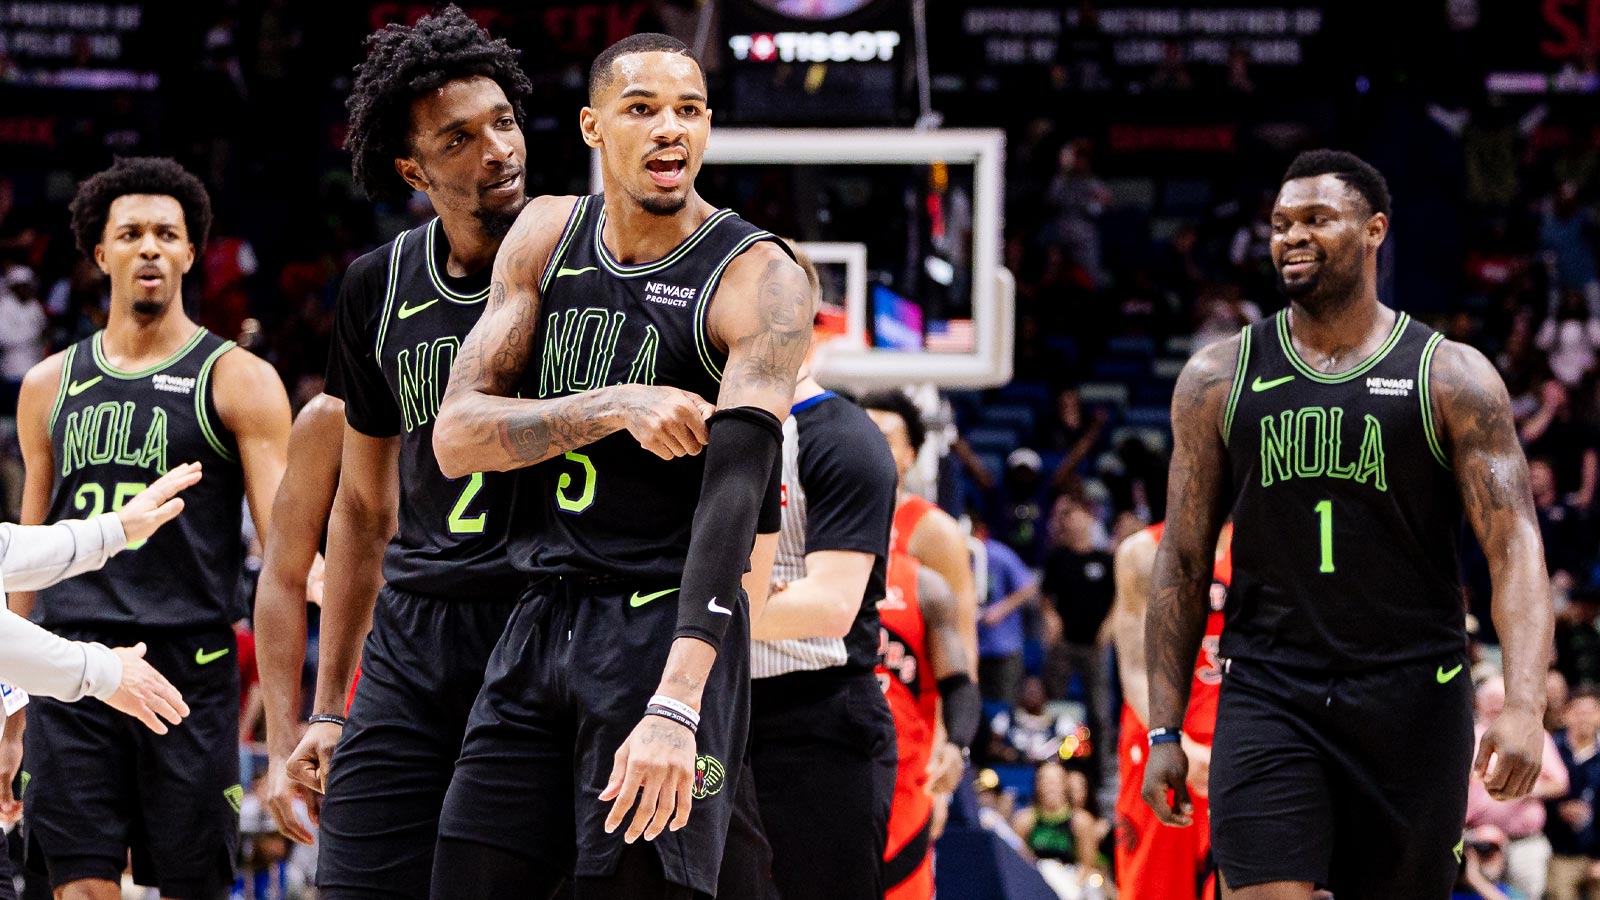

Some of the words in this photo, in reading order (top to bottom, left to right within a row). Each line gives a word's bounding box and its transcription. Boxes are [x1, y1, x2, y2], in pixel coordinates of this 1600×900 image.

[774, 30, 901, 62] TISSOT
[644, 281, 697, 299] NEWAGE
[645, 294, 688, 307] PRODUCTS
[397, 335, 461, 433] NO
[1366, 377, 1414, 390] NEWAGE
[62, 401, 169, 477] NOLA
[1260, 406, 1388, 493] NOLA
[1313, 499, 1336, 574] 1
